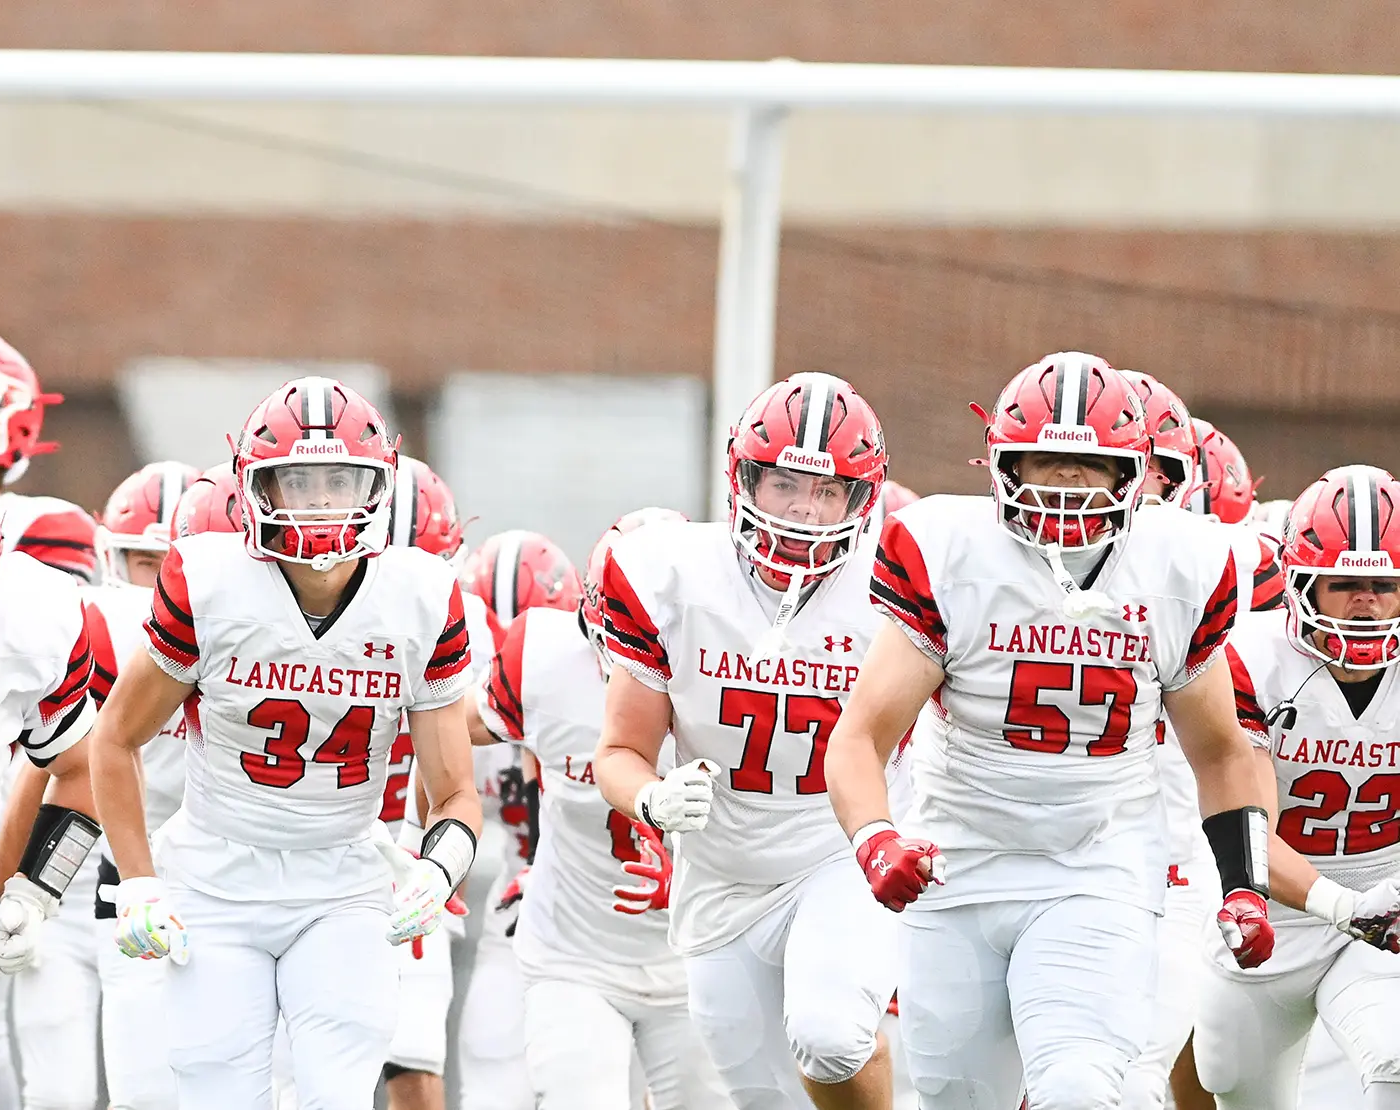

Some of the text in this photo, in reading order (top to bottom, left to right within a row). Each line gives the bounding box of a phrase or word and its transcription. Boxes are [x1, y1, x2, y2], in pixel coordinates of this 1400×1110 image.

[296, 444, 343, 455] Riddell
[1044, 429, 1092, 442] Riddell
[784, 451, 831, 469] Riddell
[1342, 557, 1387, 568] Riddell
[988, 623, 1152, 663] LANCASTER
[226, 657, 401, 699] LANCASTER
[699, 647, 859, 692] LANCASTER
[1002, 660, 1138, 757] 57
[240, 697, 375, 789] 34
[718, 687, 843, 795] 77
[1276, 733, 1400, 767] LANCAST
[1275, 769, 1400, 856] 22
